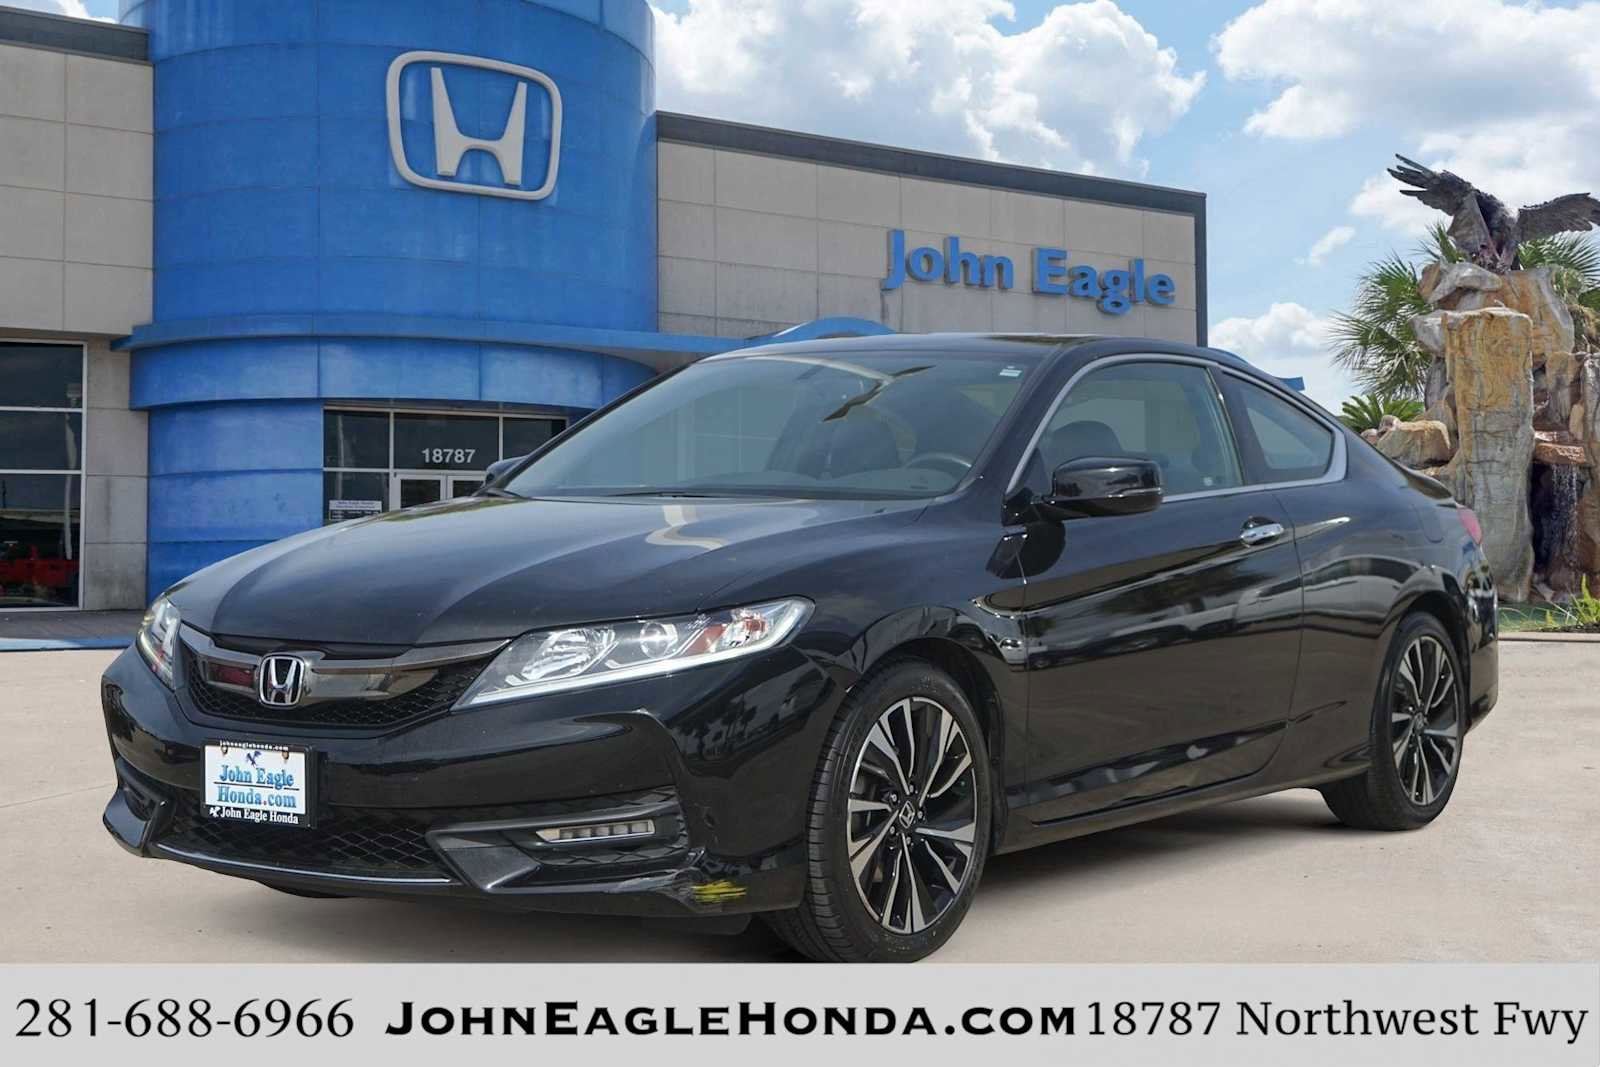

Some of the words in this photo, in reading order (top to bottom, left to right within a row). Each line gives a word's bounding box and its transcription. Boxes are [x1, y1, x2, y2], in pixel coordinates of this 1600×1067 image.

[880, 229, 1014, 291] John
[1031, 247, 1176, 316] Eagle
[421, 448, 476, 464] 18787
[220, 765, 253, 784] John
[256, 768, 294, 790] Eagle
[217, 785, 297, 809] Honda.com
[220, 807, 242, 819] John
[244, 809, 268, 823] Eagle
[269, 812, 299, 825] Honda
